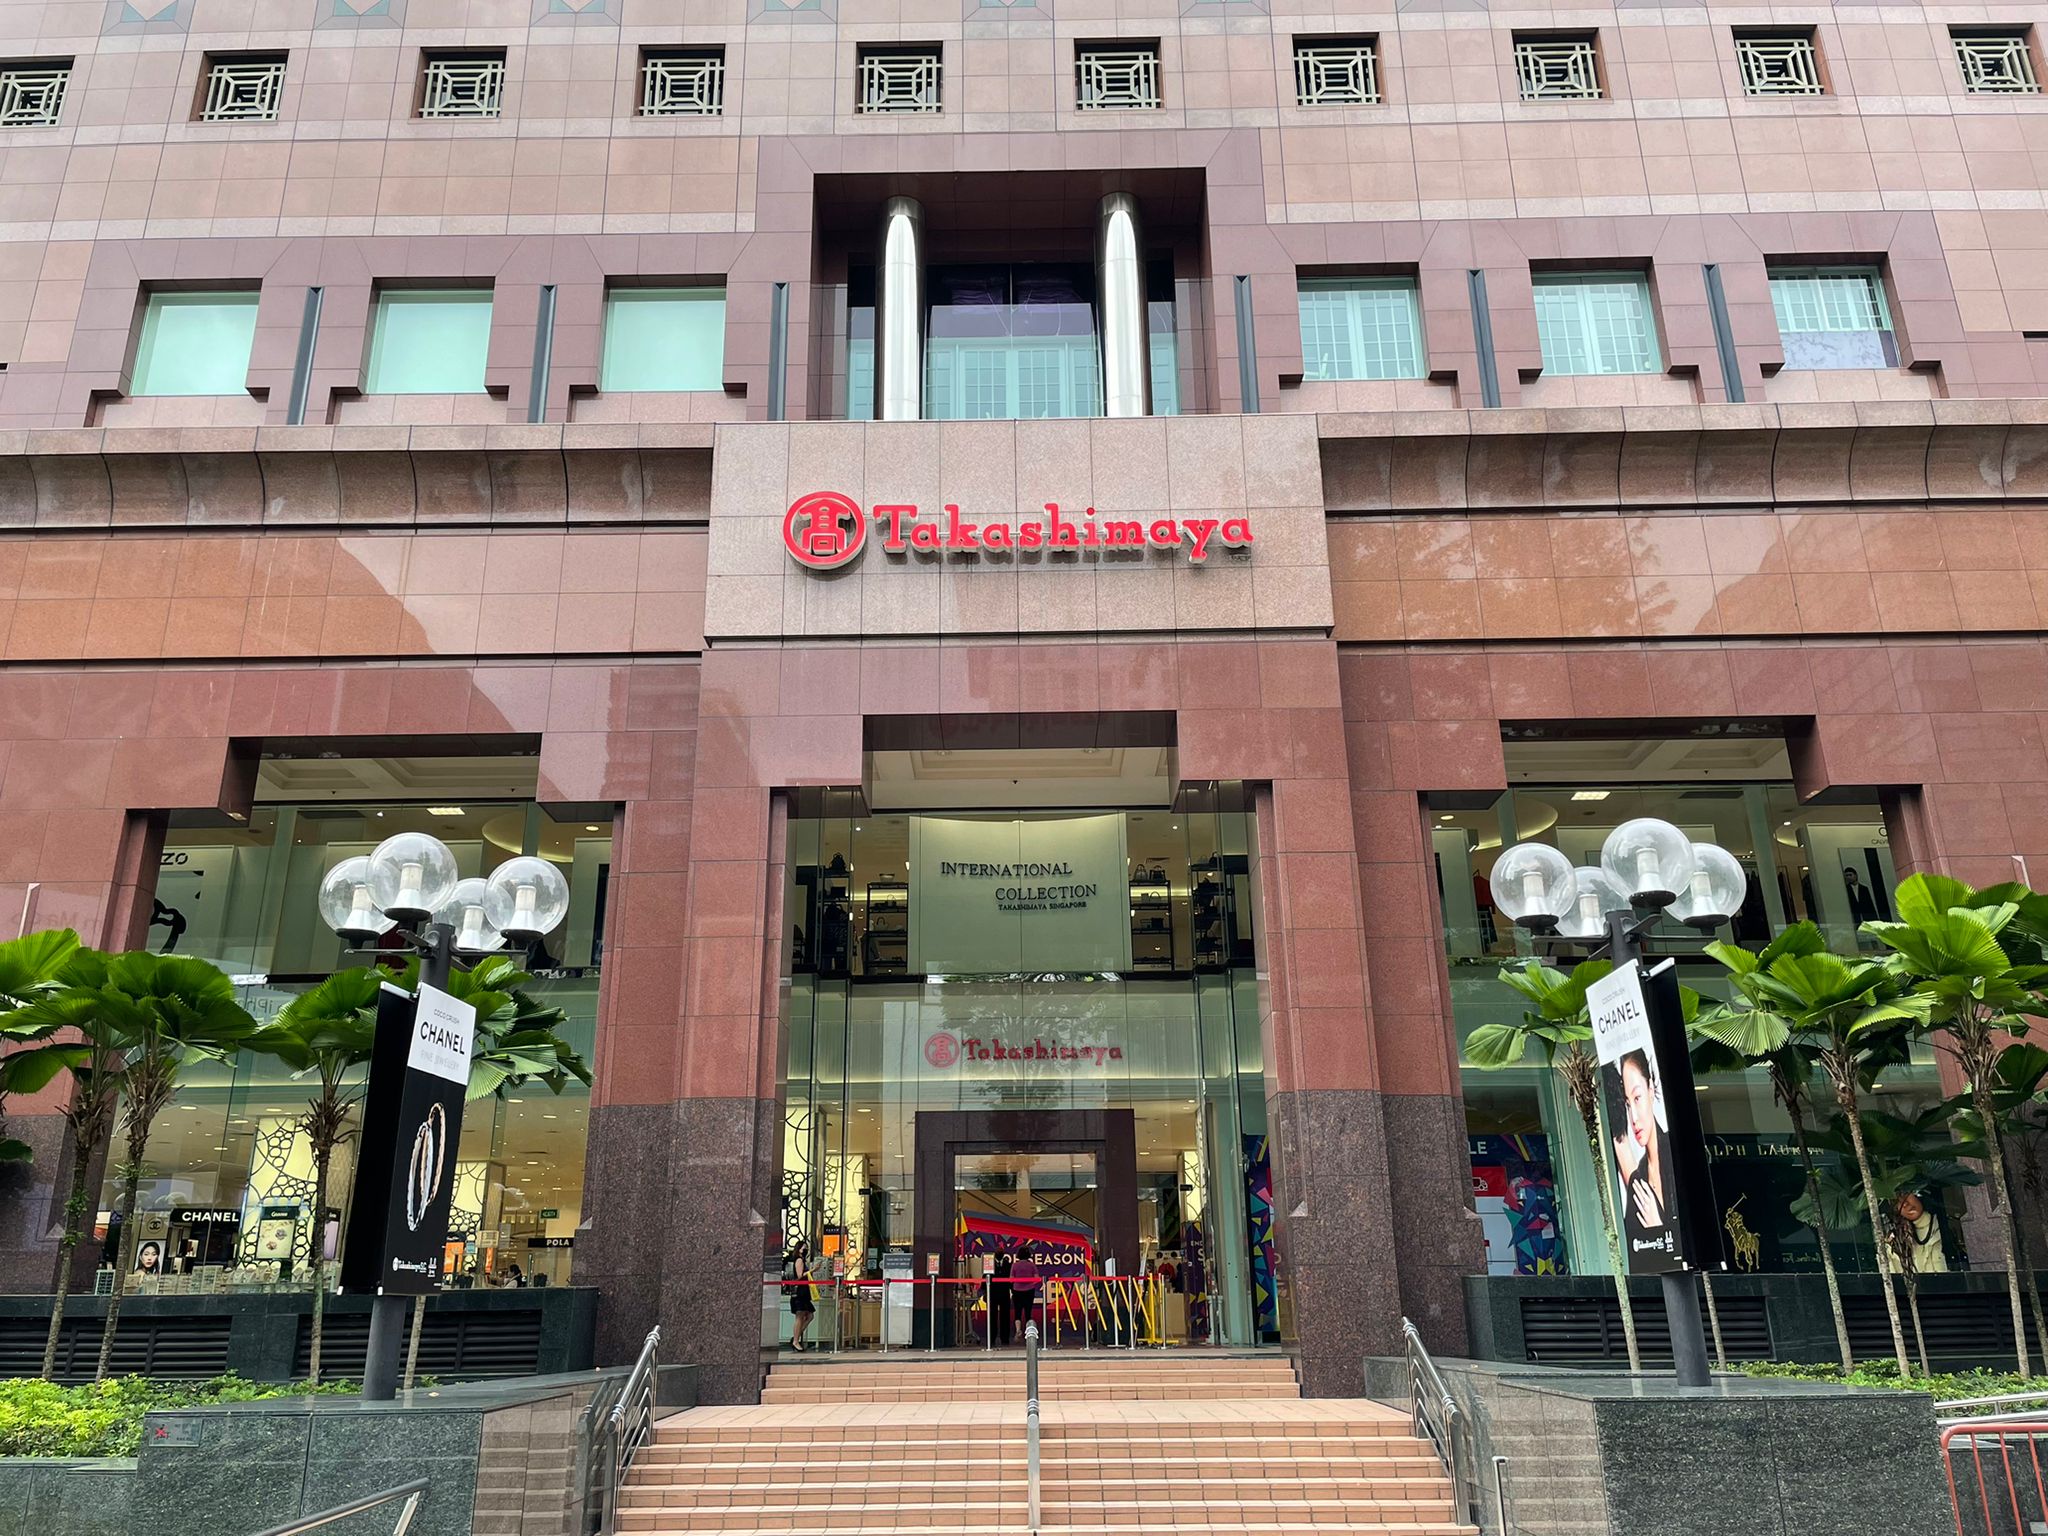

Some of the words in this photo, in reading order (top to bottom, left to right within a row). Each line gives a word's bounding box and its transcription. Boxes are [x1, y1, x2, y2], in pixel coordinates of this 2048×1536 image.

[872, 503, 1254, 563] Takashimaya
[941, 861, 1073, 877] INTERNATIONAL
[995, 884, 1097, 901] COLLECTION
[998, 903, 1048, 911] TAKASHIMAYA
[1049, 901, 1088, 910] SINGAPORE
[1598, 999, 1640, 1034] CHANEL
[420, 1021, 465, 1055] CHANEL
[961, 1038, 1123, 1066] Takashimaya
[181, 1211, 240, 1223] CHANEL
[546, 1239, 570, 1247] POLA
